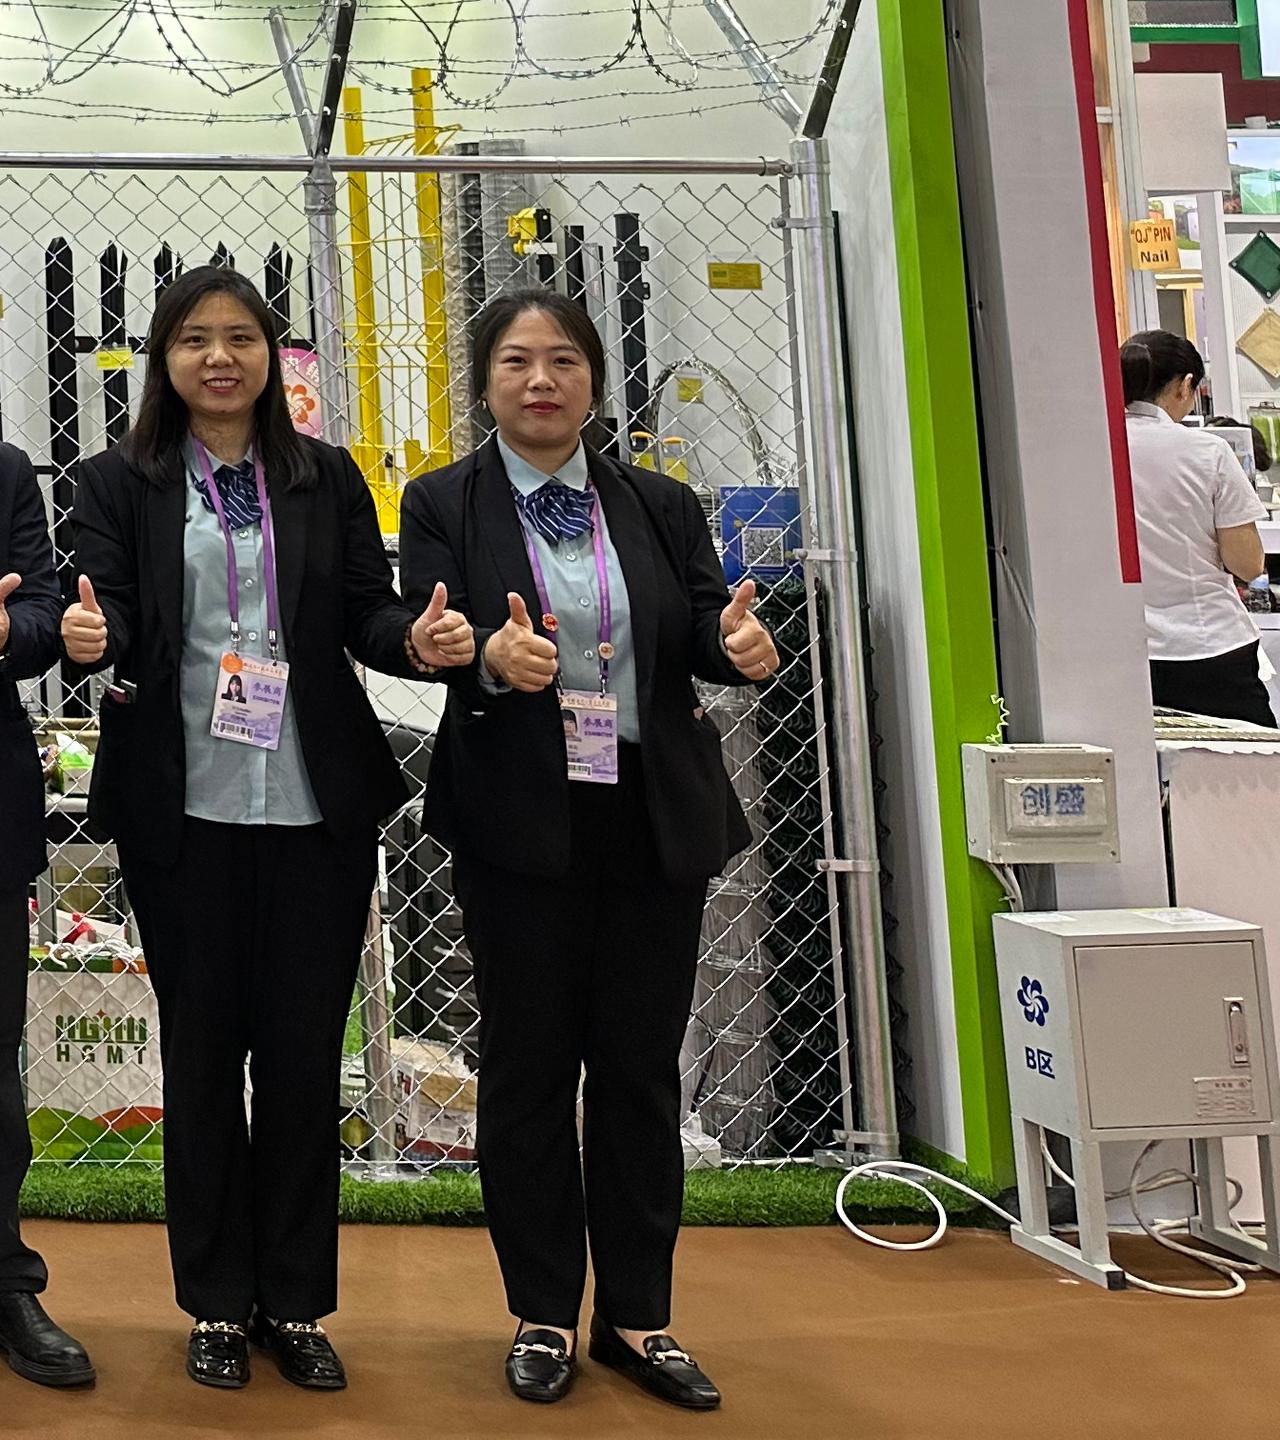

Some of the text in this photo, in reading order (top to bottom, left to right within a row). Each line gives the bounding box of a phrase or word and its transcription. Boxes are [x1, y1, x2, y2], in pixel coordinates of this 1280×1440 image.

[1153, 226, 1171, 242] PIN
[1140, 249, 1169, 263] Nail
[1024, 1046, 1056, 1080] B区
